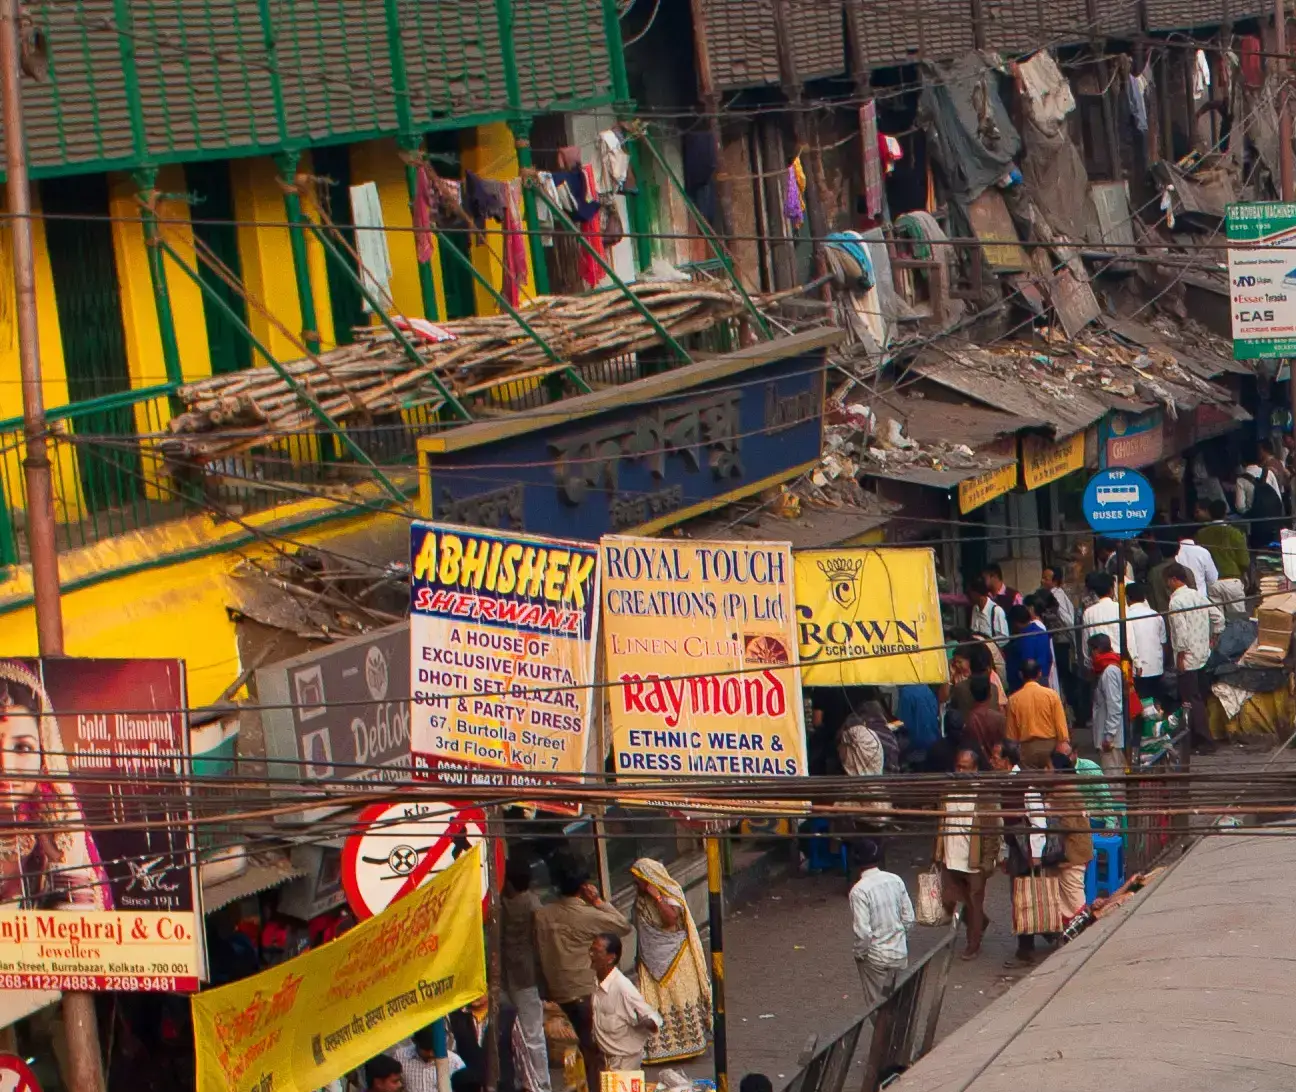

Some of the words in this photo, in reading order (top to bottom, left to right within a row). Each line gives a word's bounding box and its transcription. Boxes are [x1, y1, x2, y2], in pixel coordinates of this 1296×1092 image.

[1240, 310, 1274, 322] CAS
[1093, 511, 1122, 520] BUSES
[1125, 509, 1148, 519] ONLY
[414, 531, 594, 609] ABHISHEK
[606, 547, 689, 581] ROYAL
[696, 549, 785, 585] TOUCH
[415, 588, 586, 633] SHERWANI
[607, 589, 717, 618] CREATIONS
[723, 593, 747, 620] (P)
[451, 629, 461, 644] A
[467, 631, 523, 653] HOUSE
[529, 641, 550, 656] OF
[611, 634, 678, 656] LINEN
[683, 636, 743, 659] CLUB
[422, 646, 512, 674] EXCLUSIVE
[518, 662, 578, 686] KURTA,
[419, 669, 467, 690] DHOTI
[473, 678, 506, 699] SET,
[512, 684, 579, 712] BLAZAR,
[620, 669, 785, 727] Raymond
[414, 691, 450, 709] SUIT
[458, 697, 468, 713] &
[474, 700, 525, 722] PARTY
[531, 711, 582, 733] DRESS
[78, 715, 111, 741] Gold,
[116, 713, 174, 741] Diamond
[430, 715, 451, 732] 67,
[457, 719, 516, 742] Burtolla
[522, 731, 565, 751] Street
[629, 730, 701, 749] ETHNIC
[708, 733, 764, 751] WEAR
[771, 735, 783, 752] &
[435, 736, 459, 751] 3rd
[464, 741, 506, 763] Floor,
[512, 749, 537, 765] Kol
[551, 757, 559, 769] 7
[620, 753, 682, 771] DRESS
[688, 755, 797, 776] MATERIALS
[121, 896, 150, 907] Since
[155, 896, 179, 907] 1911
[36, 916, 122, 944] Meghraj
[132, 917, 149, 939] &
[157, 917, 192, 940] Co.
[37, 945, 100, 959] Jewellers
[17, 961, 47, 974] Street,
[52, 962, 106, 975] Burrabazar,
[109, 963, 145, 973] Kolkata
[105, 976, 176, 992] 2269-9481
